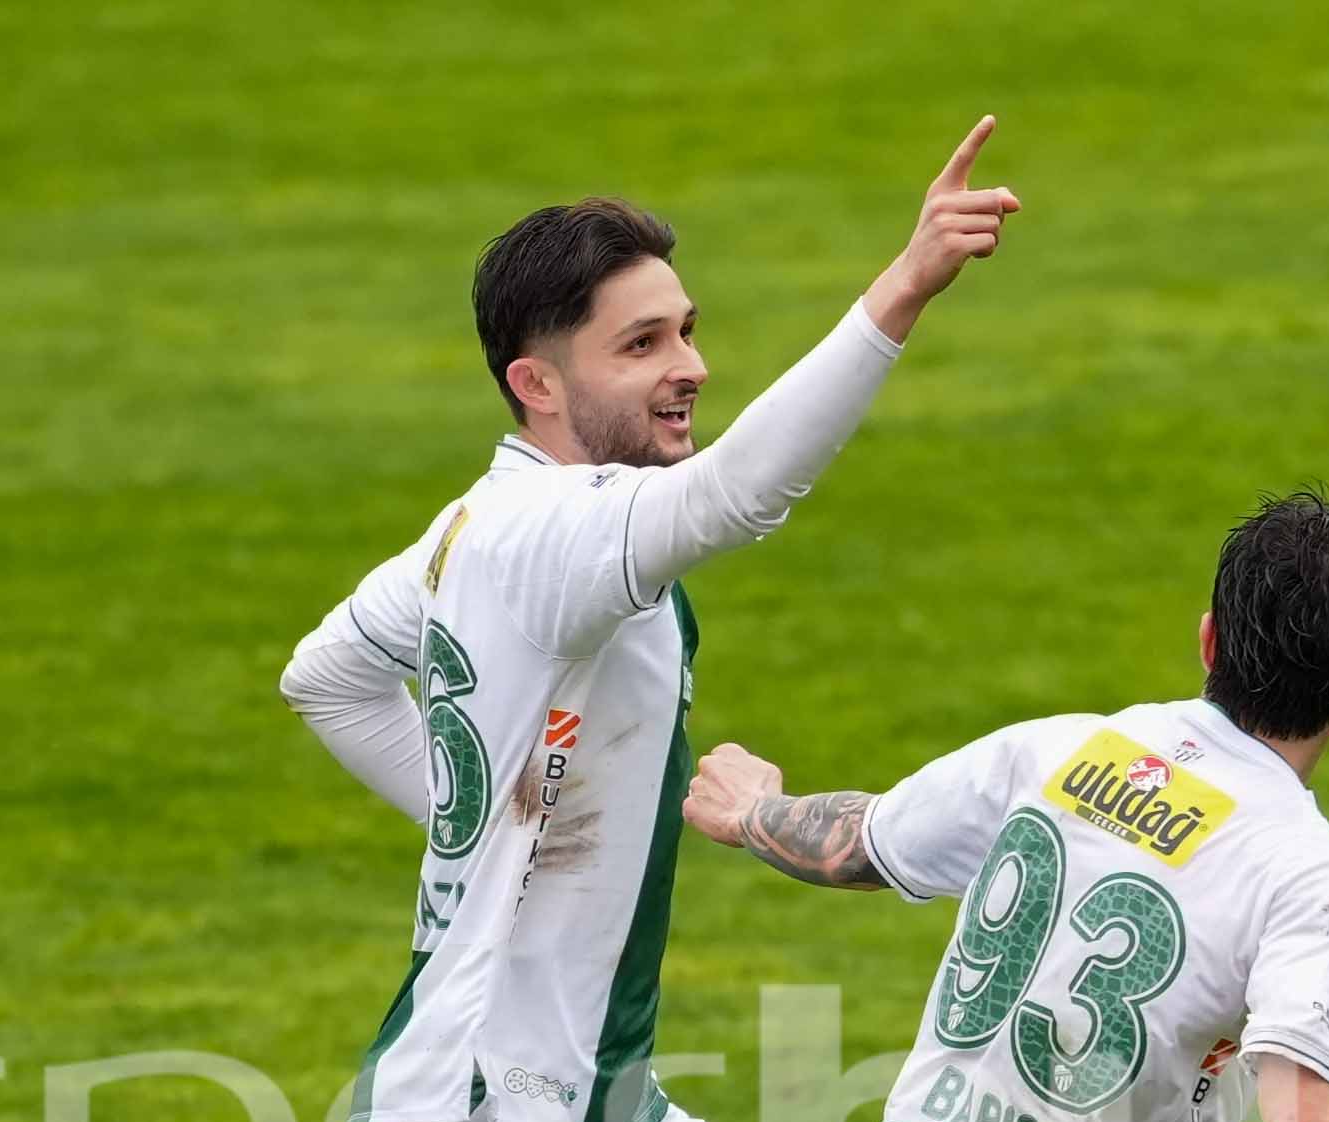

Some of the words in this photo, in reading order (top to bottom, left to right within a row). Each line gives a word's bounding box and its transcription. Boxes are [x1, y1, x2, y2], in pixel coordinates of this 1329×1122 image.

[422, 618, 492, 860] 6
[1062, 761, 1205, 856] uludağ
[935, 807, 1187, 1114] 93
